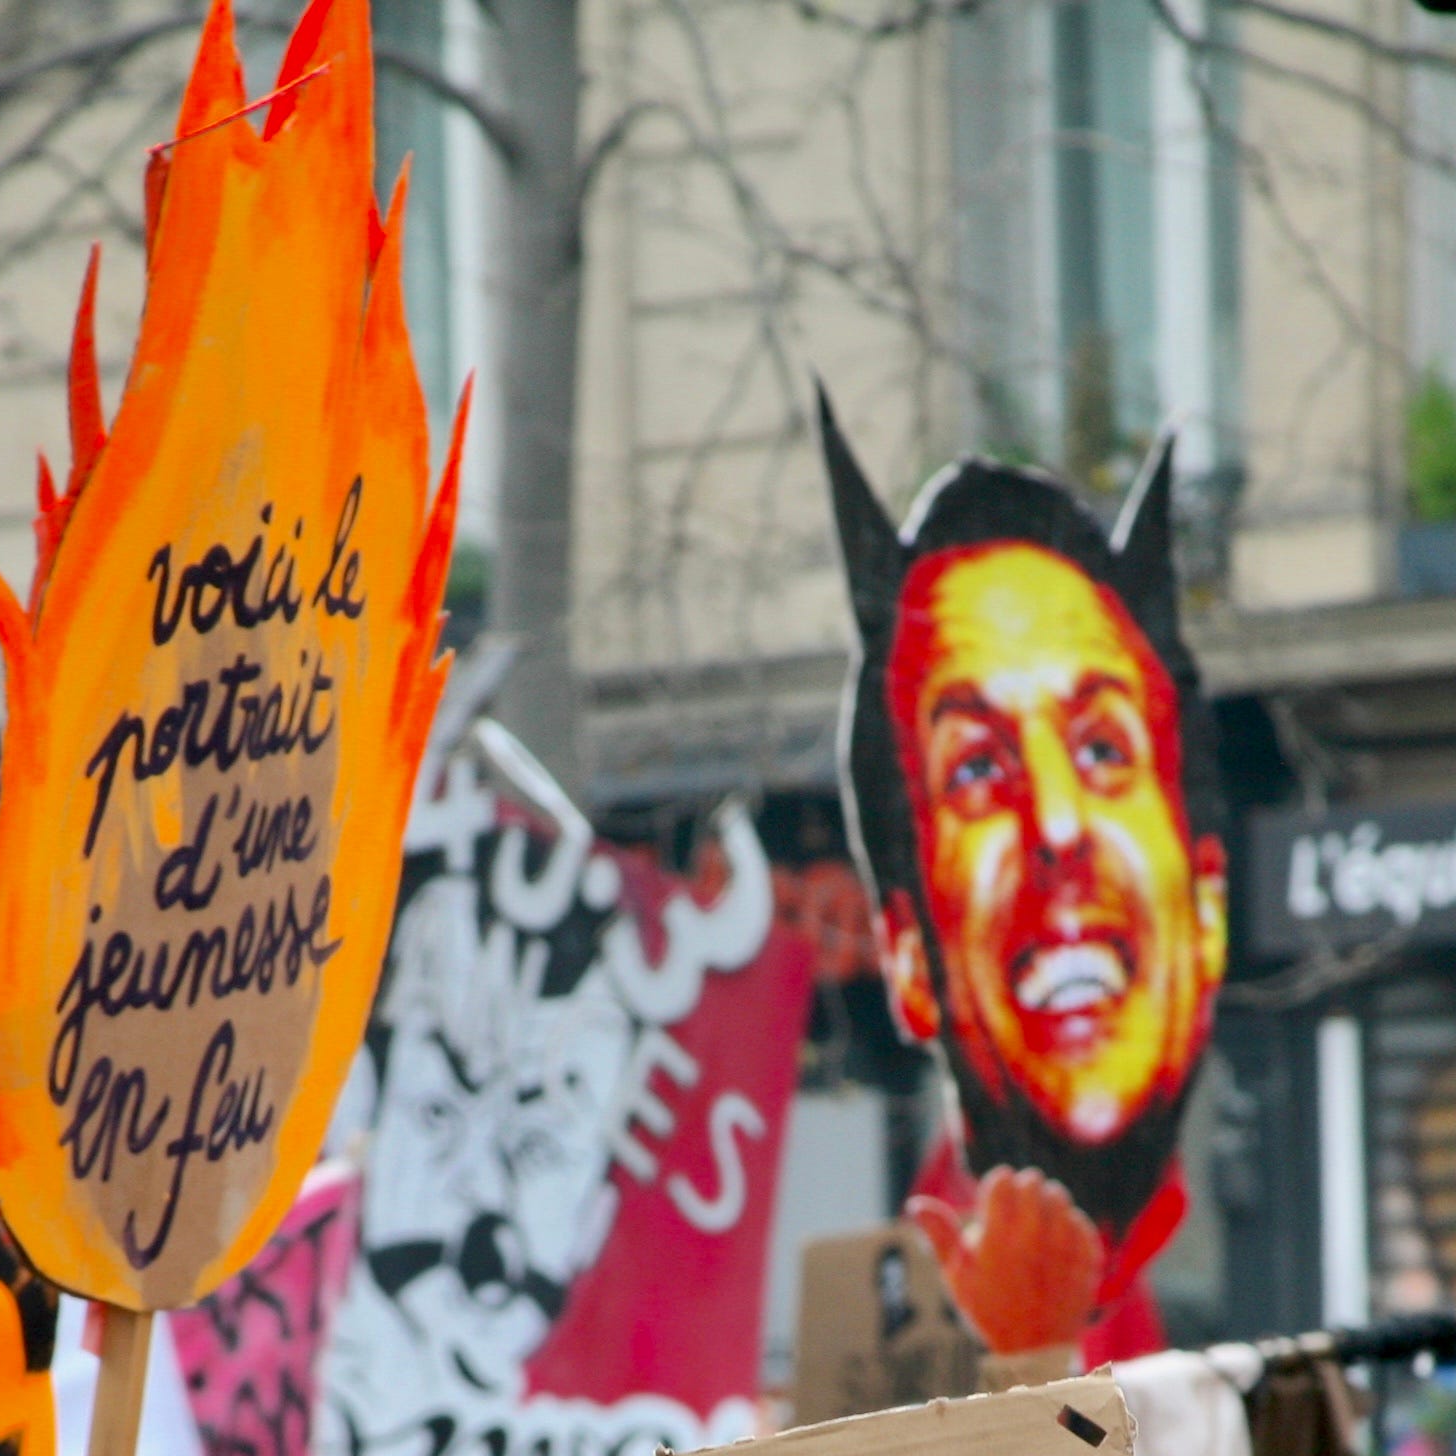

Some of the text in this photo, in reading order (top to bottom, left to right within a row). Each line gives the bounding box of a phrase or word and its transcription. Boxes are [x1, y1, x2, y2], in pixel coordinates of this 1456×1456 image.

[146, 474, 365, 646] voici le
[86, 650, 335, 860] portrait
[154, 785, 318, 912] d'une
[48, 873, 346, 1107] jeunesse
[58, 1017, 274, 1271] en feu
